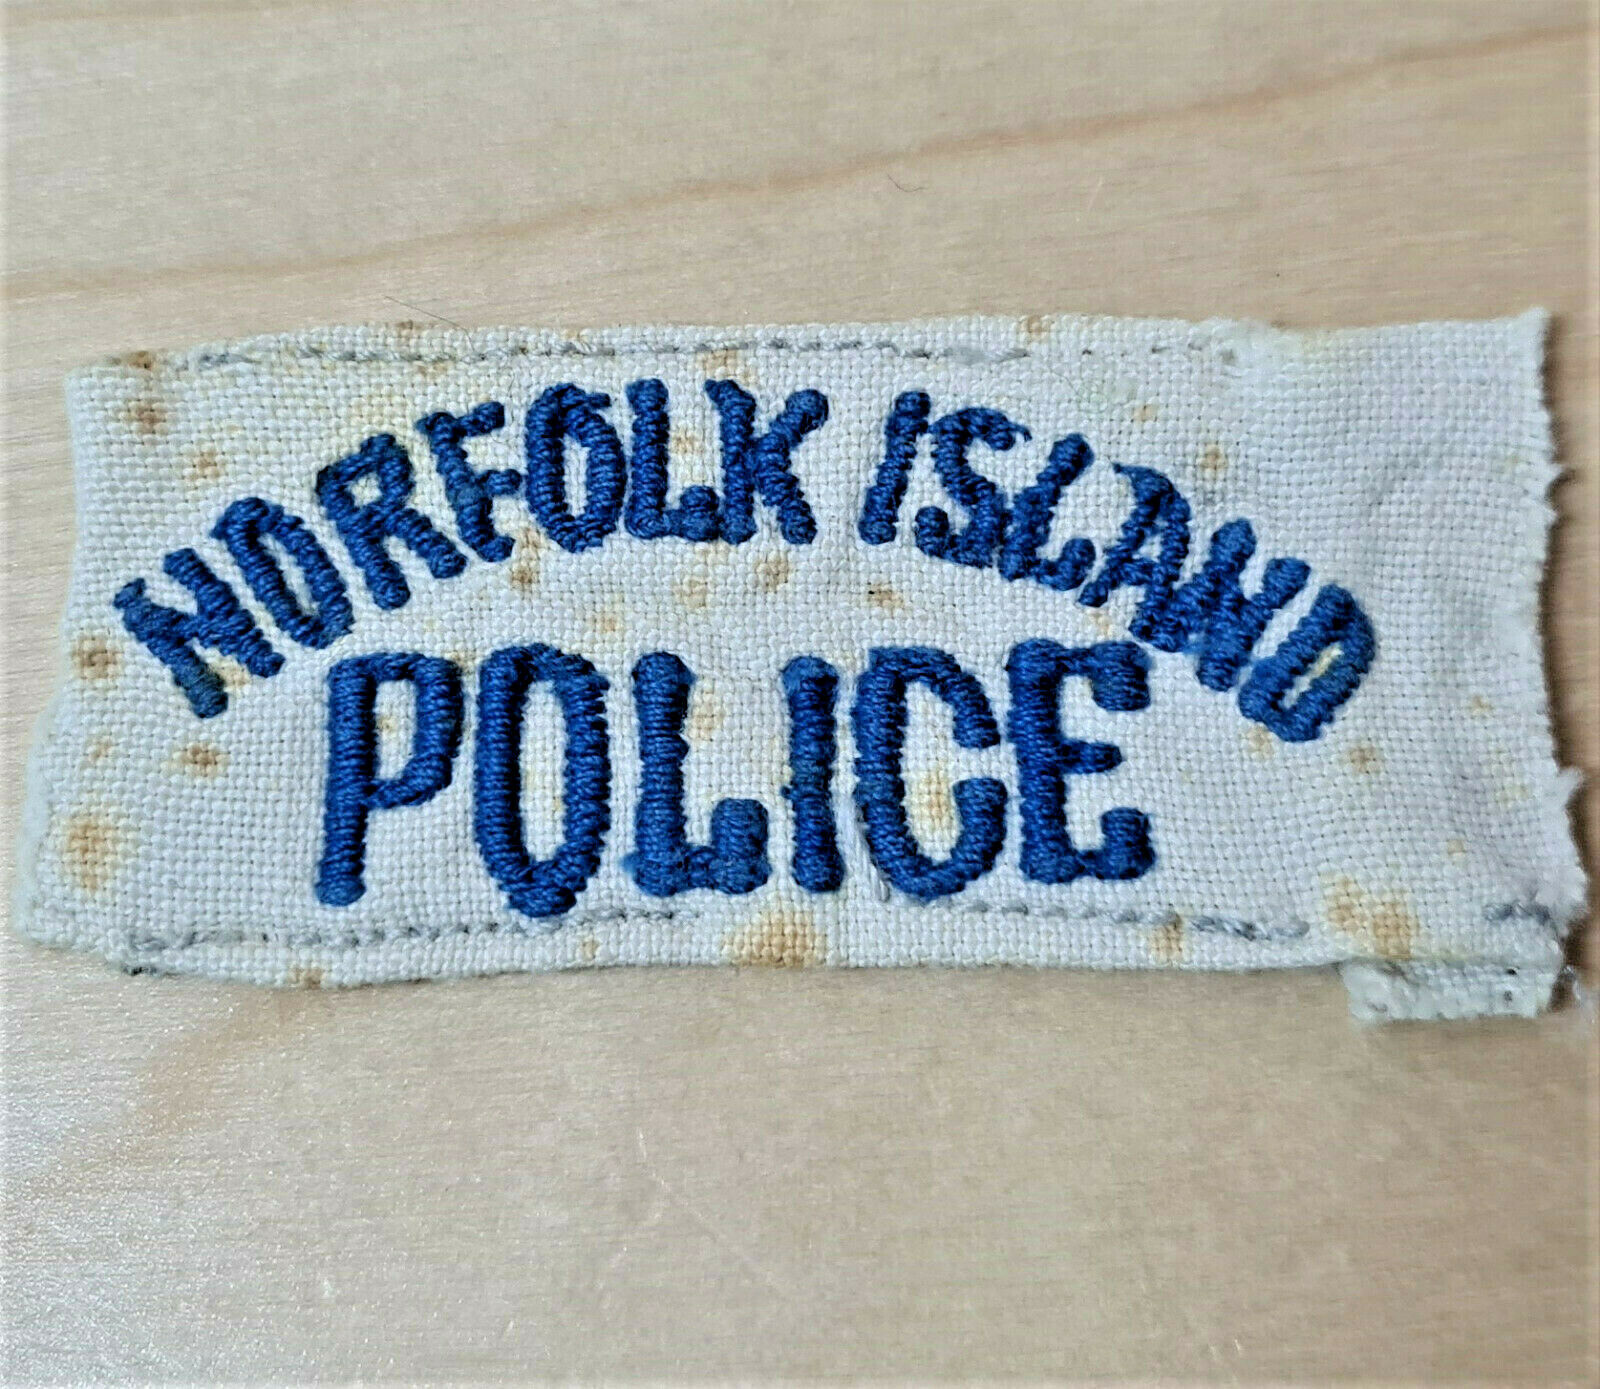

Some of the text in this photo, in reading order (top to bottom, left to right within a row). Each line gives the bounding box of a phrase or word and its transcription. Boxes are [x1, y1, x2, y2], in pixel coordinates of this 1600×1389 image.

[112, 377, 1377, 743] NORFOLK ISLAND
[313, 637, 1157, 921] POLICE
